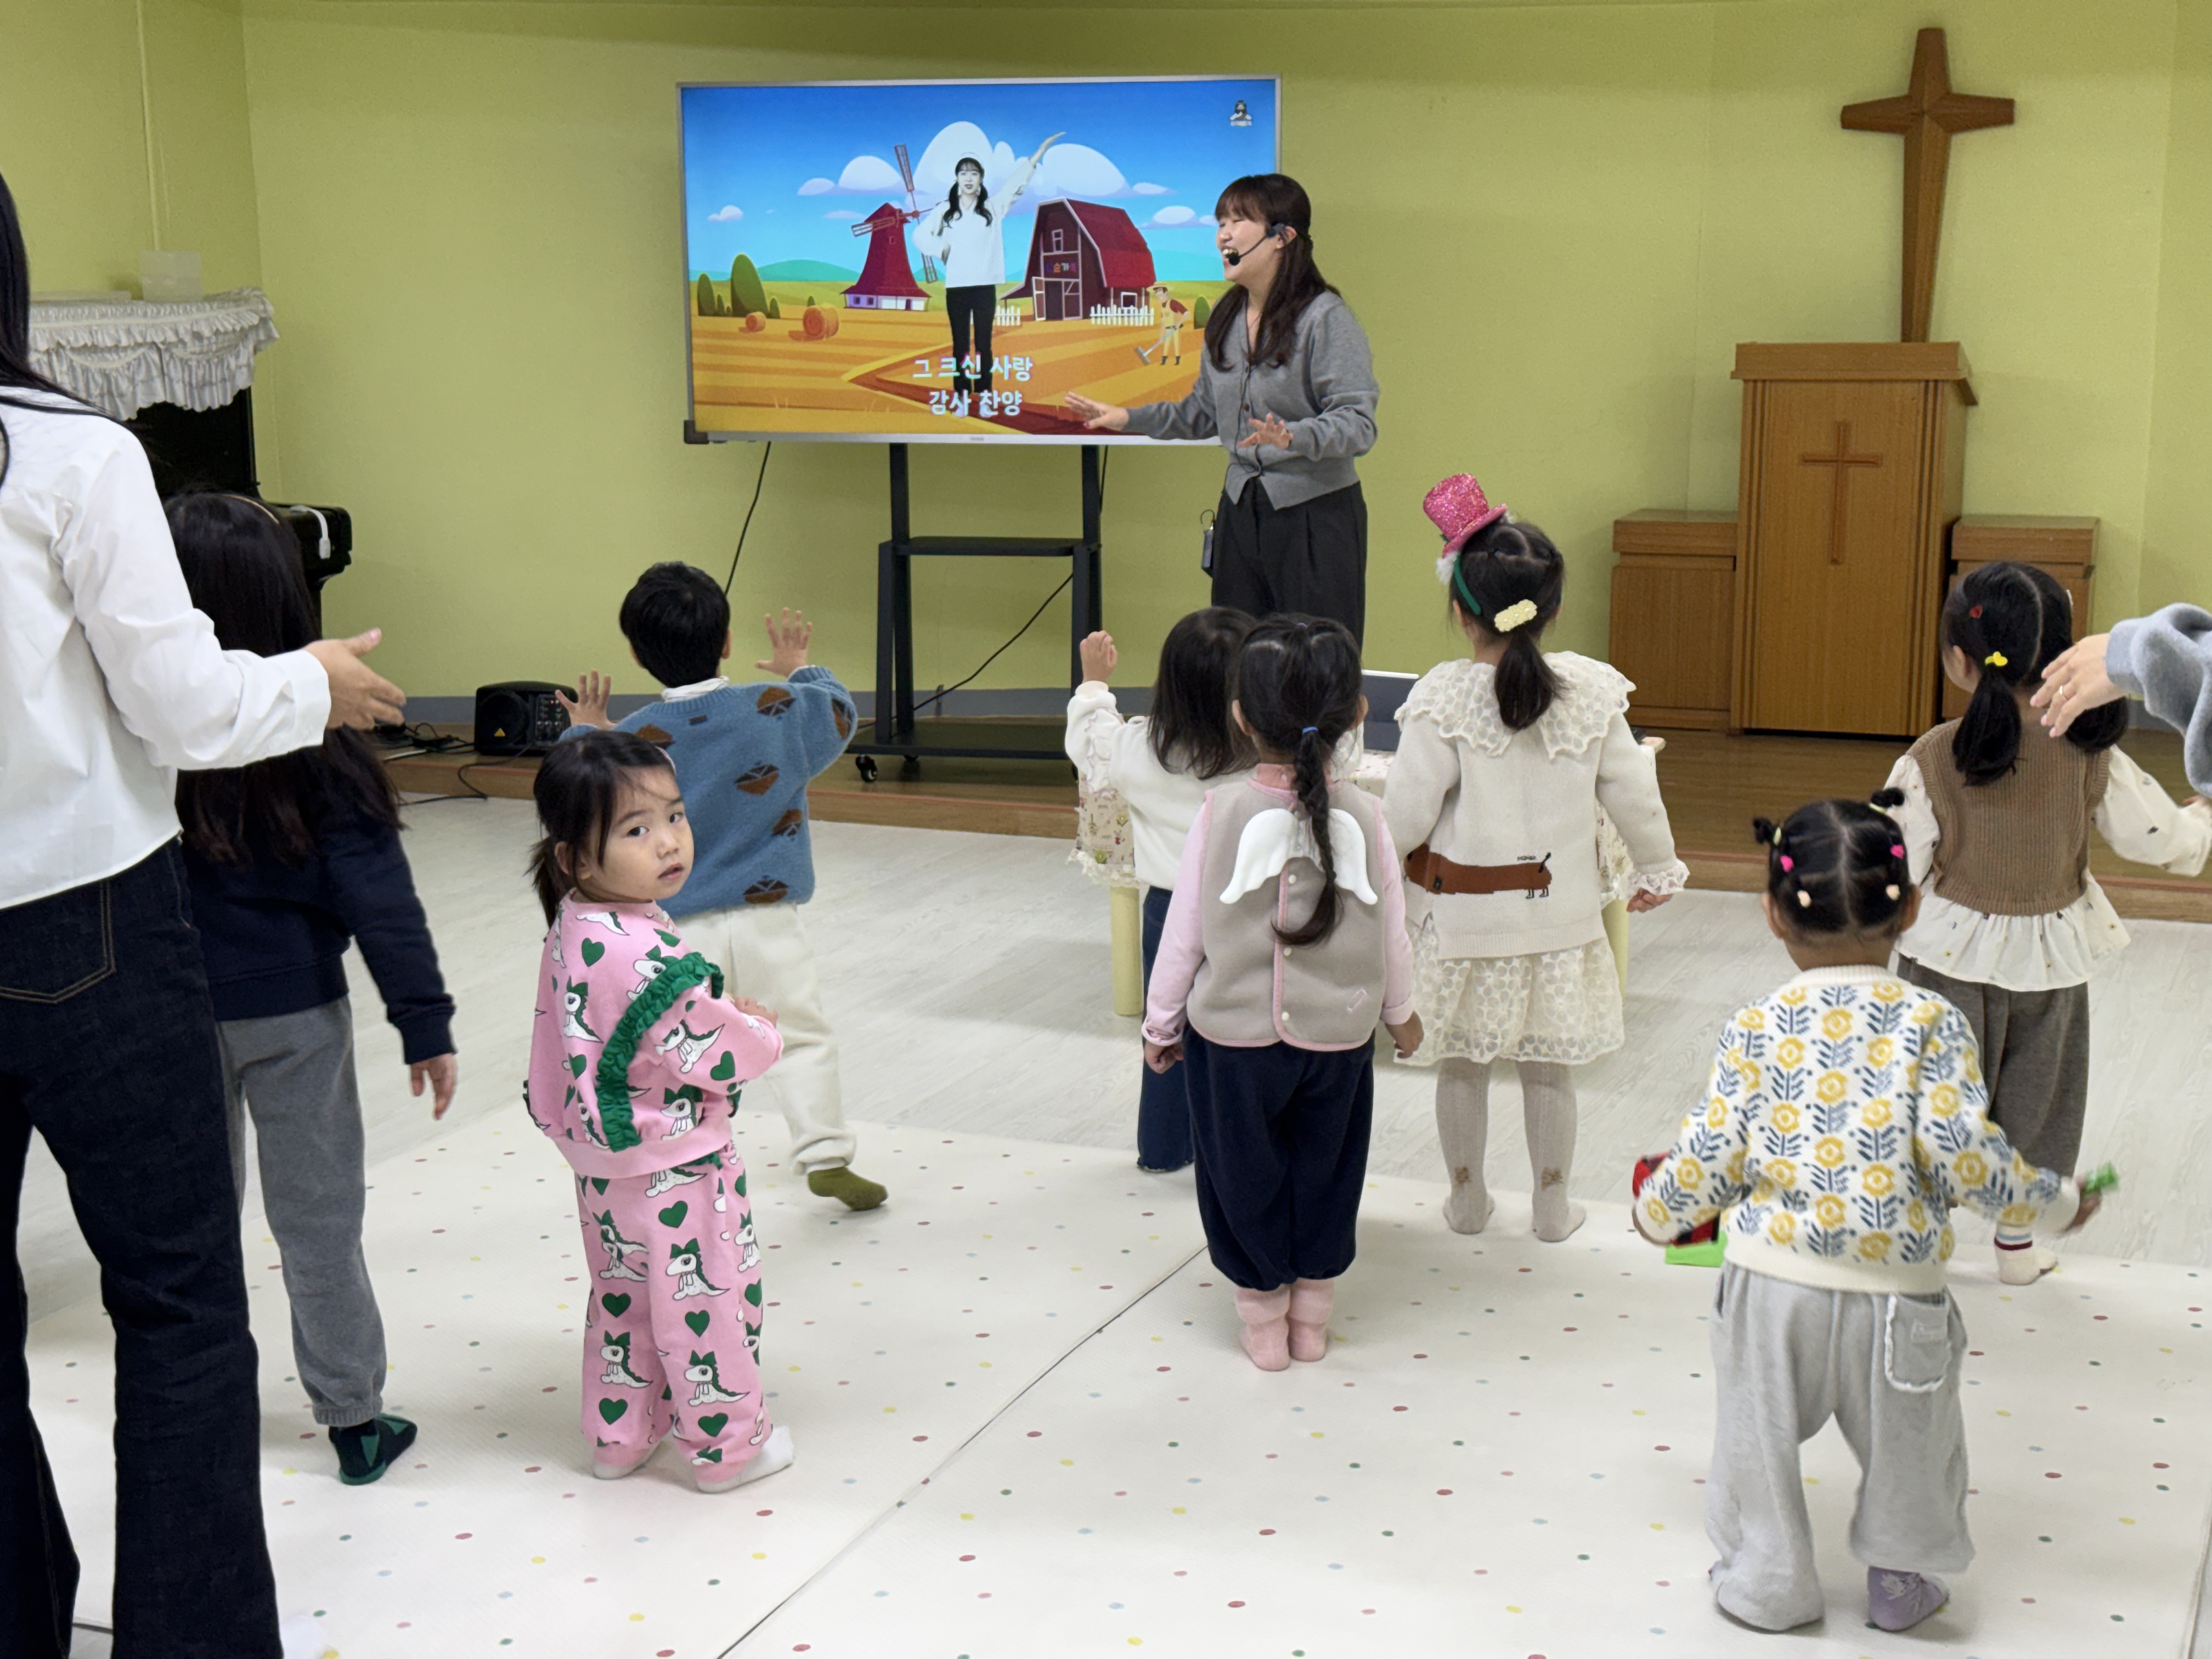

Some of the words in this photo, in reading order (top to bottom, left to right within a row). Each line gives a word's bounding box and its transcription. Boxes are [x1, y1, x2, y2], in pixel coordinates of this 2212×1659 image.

[912, 359, 932, 377] 그
[938, 353, 981, 379] 크신
[989, 354, 1033, 381] 사랑
[929, 390, 972, 416] 감사
[979, 390, 1023, 416] 찬양
